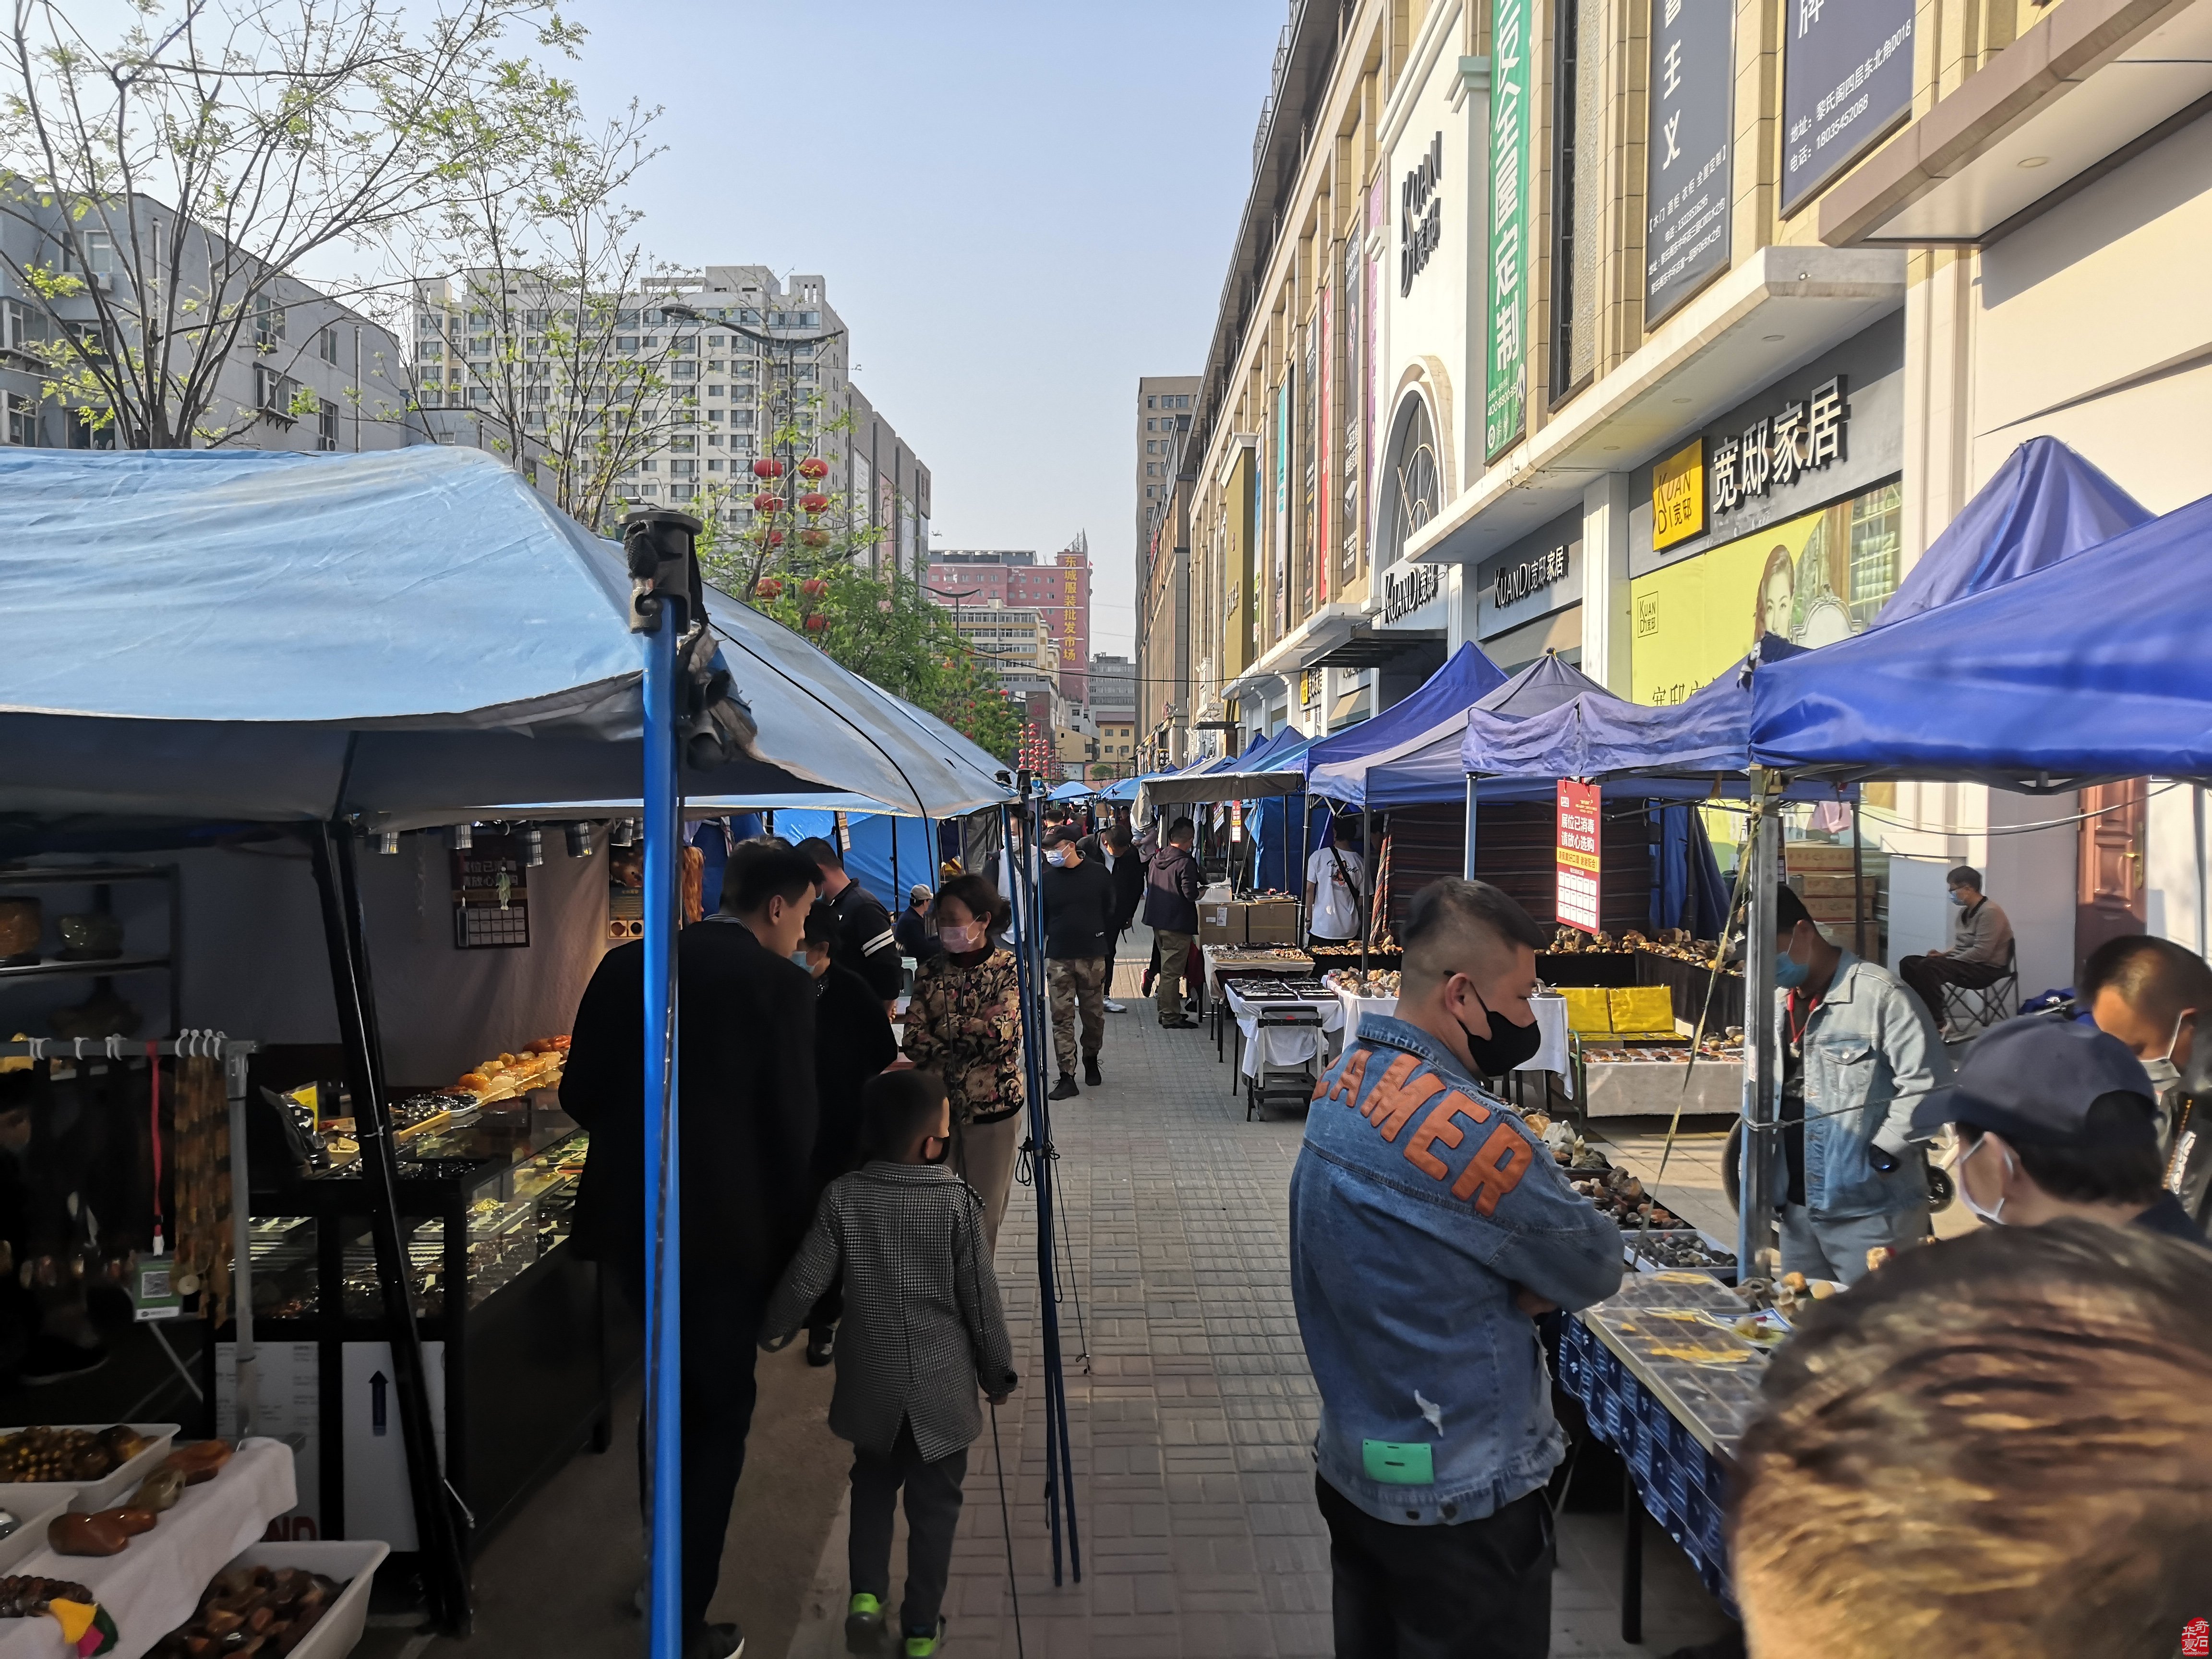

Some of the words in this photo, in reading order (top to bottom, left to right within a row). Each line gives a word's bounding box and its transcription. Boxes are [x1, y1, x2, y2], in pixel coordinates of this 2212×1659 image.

[1496, 0, 1521, 372] 友全屋定制
[1712, 375, 1849, 514] 宽邸家居
[1658, 469, 1691, 513] KUAN
[1063, 555, 1077, 661] 东城服装批发市场
[1639, 600, 1656, 623] KUAN
[1561, 813, 1595, 834] 展位已消毒
[1561, 831, 1595, 853] 请放心选购
